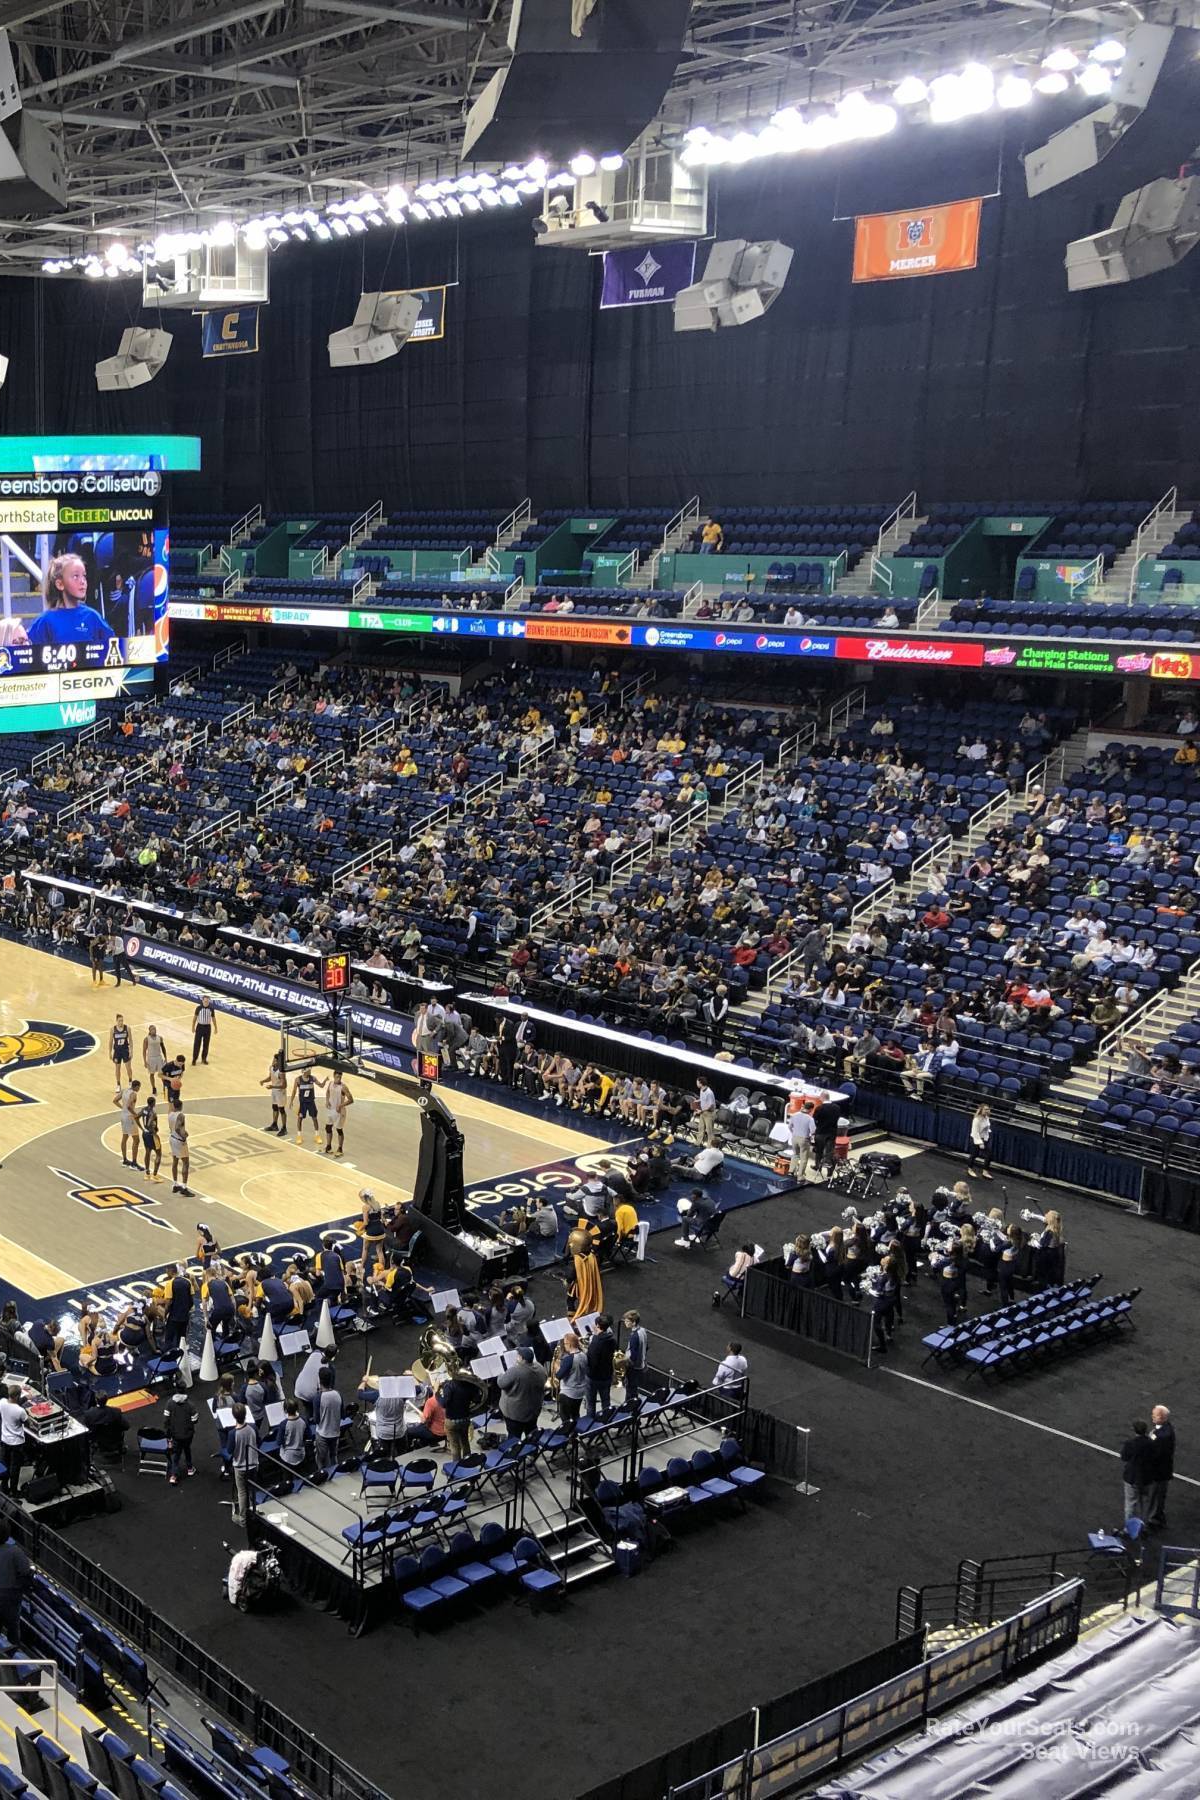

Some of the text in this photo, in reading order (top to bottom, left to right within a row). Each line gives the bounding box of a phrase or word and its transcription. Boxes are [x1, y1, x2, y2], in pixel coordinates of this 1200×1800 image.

[890, 255, 936, 271] MERCER
[628, 287, 665, 300] FURMAN
[221, 313, 240, 340] C
[84, 473, 155, 493] Coliseum
[59, 507, 153, 524] GREEN LINCOLN
[281, 612, 311, 621] BRADY
[358, 615, 411, 629] TFA CLUB
[527, 624, 544, 635] RIDING
[545, 625, 558, 636] HIGH
[660, 631, 693, 640] Greensboro
[660, 638, 686, 646] Coliseum
[726, 637, 742, 645] pepsi
[768, 640, 785, 648] pepsi
[812, 642, 829, 651] pepsi
[42, 644, 76, 663] 5:40
[866, 641, 952, 660] Budweiser
[1023, 648, 1065, 661] Charging
[1068, 650, 1109, 661] Stations
[1029, 658, 1042, 668] the
[1044, 659, 1065, 669] Main
[1068, 662, 1113, 672] Concourse
[62, 676, 114, 690] SEGRA
[328, 956, 346, 969] 5:40
[143, 946, 199, 973] SUPPORTING
[198, 963, 288, 1001] STUDENT-ATHLETE
[326, 968, 343, 988] 30
[425, 1055, 437, 1066] 5:40
[423, 1066, 435, 1077] 30
